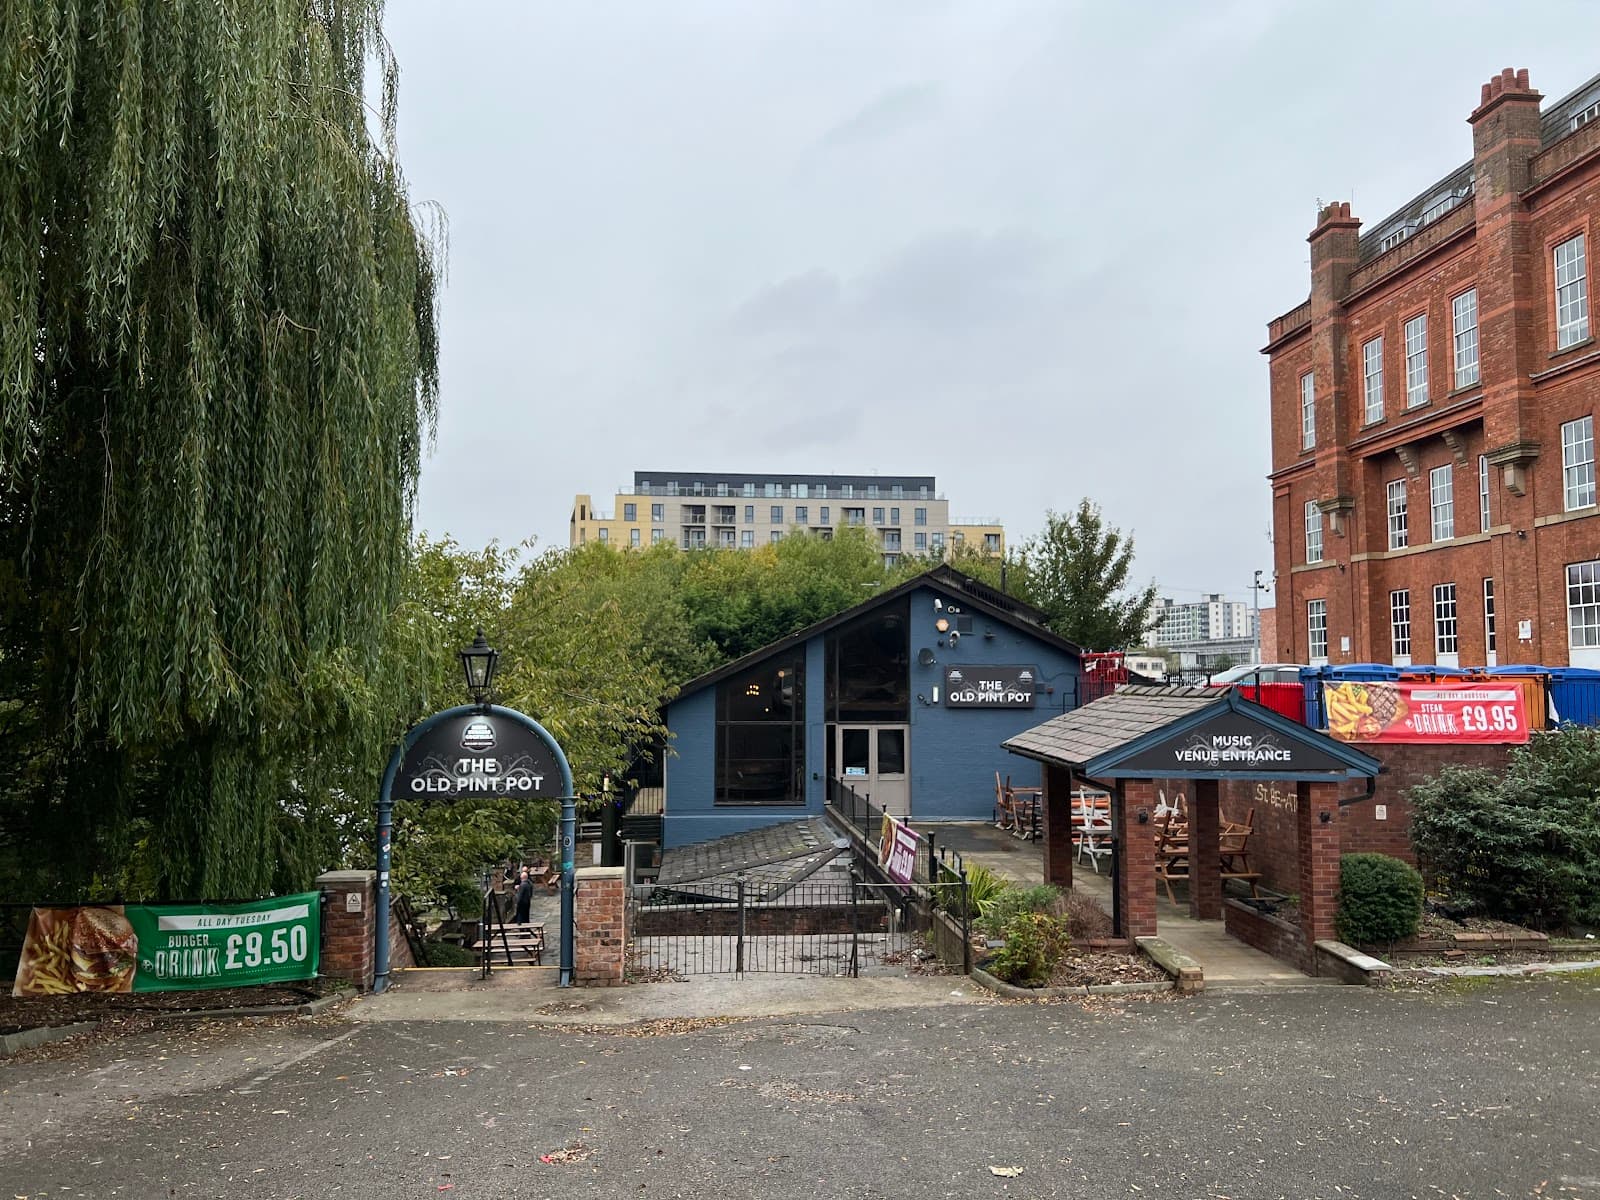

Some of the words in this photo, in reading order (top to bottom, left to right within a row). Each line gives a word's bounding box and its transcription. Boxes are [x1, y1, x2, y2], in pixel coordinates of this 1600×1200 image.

[979, 680, 1002, 690] THE
[950, 692, 975, 702] OLD
[978, 692, 1004, 703] PINT
[1007, 692, 1031, 703] POT
[1421, 703, 1443, 713] STEAK
[1413, 713, 1459, 735] DRINK
[1462, 705, 1517, 731] £9.95
[1213, 735, 1252, 746] MUSIC
[1175, 750, 1218, 761] VENUE
[1222, 750, 1291, 761] ENTRANCE
[459, 758, 497, 773] THE
[411, 777, 450, 792] OLD
[457, 777, 500, 792] PINT
[506, 777, 544, 791] POT
[197, 917, 212, 927] ALL
[216, 917, 231, 926] DAY
[235, 913, 272, 925] TUESDAY
[168, 934, 209, 948] BURGER
[224, 924, 307, 970] £9.50
[155, 947, 221, 980] DRINK
